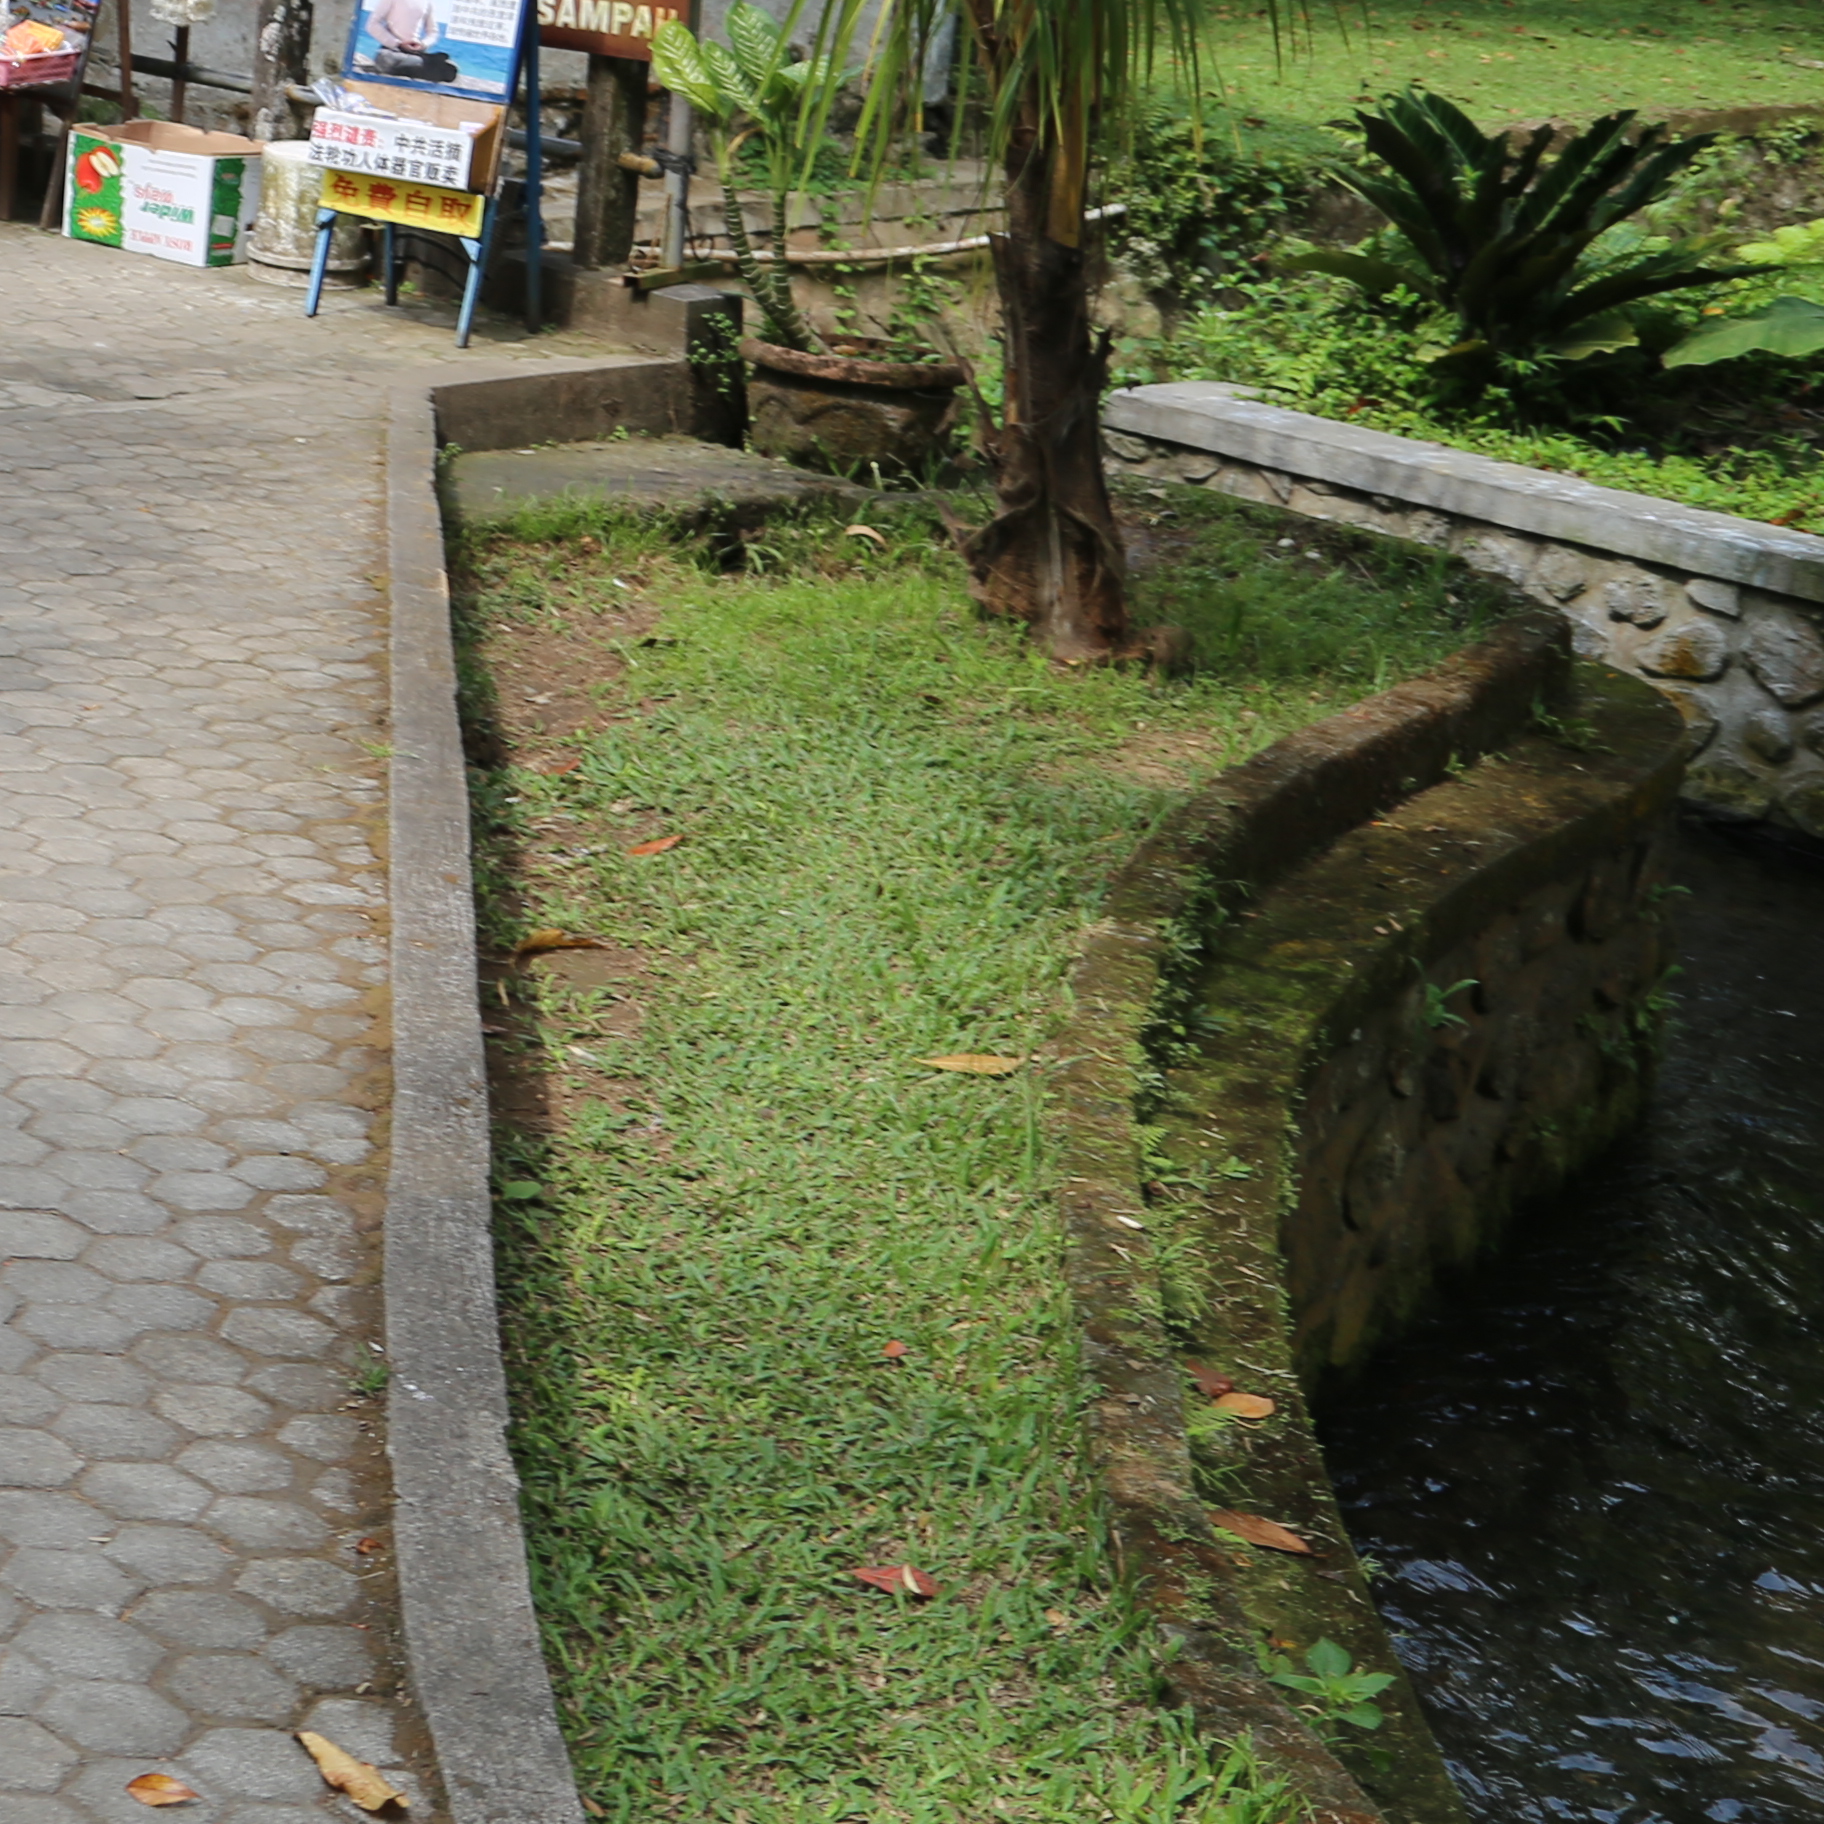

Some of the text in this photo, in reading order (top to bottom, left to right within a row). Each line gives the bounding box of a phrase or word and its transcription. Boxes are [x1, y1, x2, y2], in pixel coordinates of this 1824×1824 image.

[139, 201, 195, 224] Wider
[330, 174, 474, 228] 免費自取
